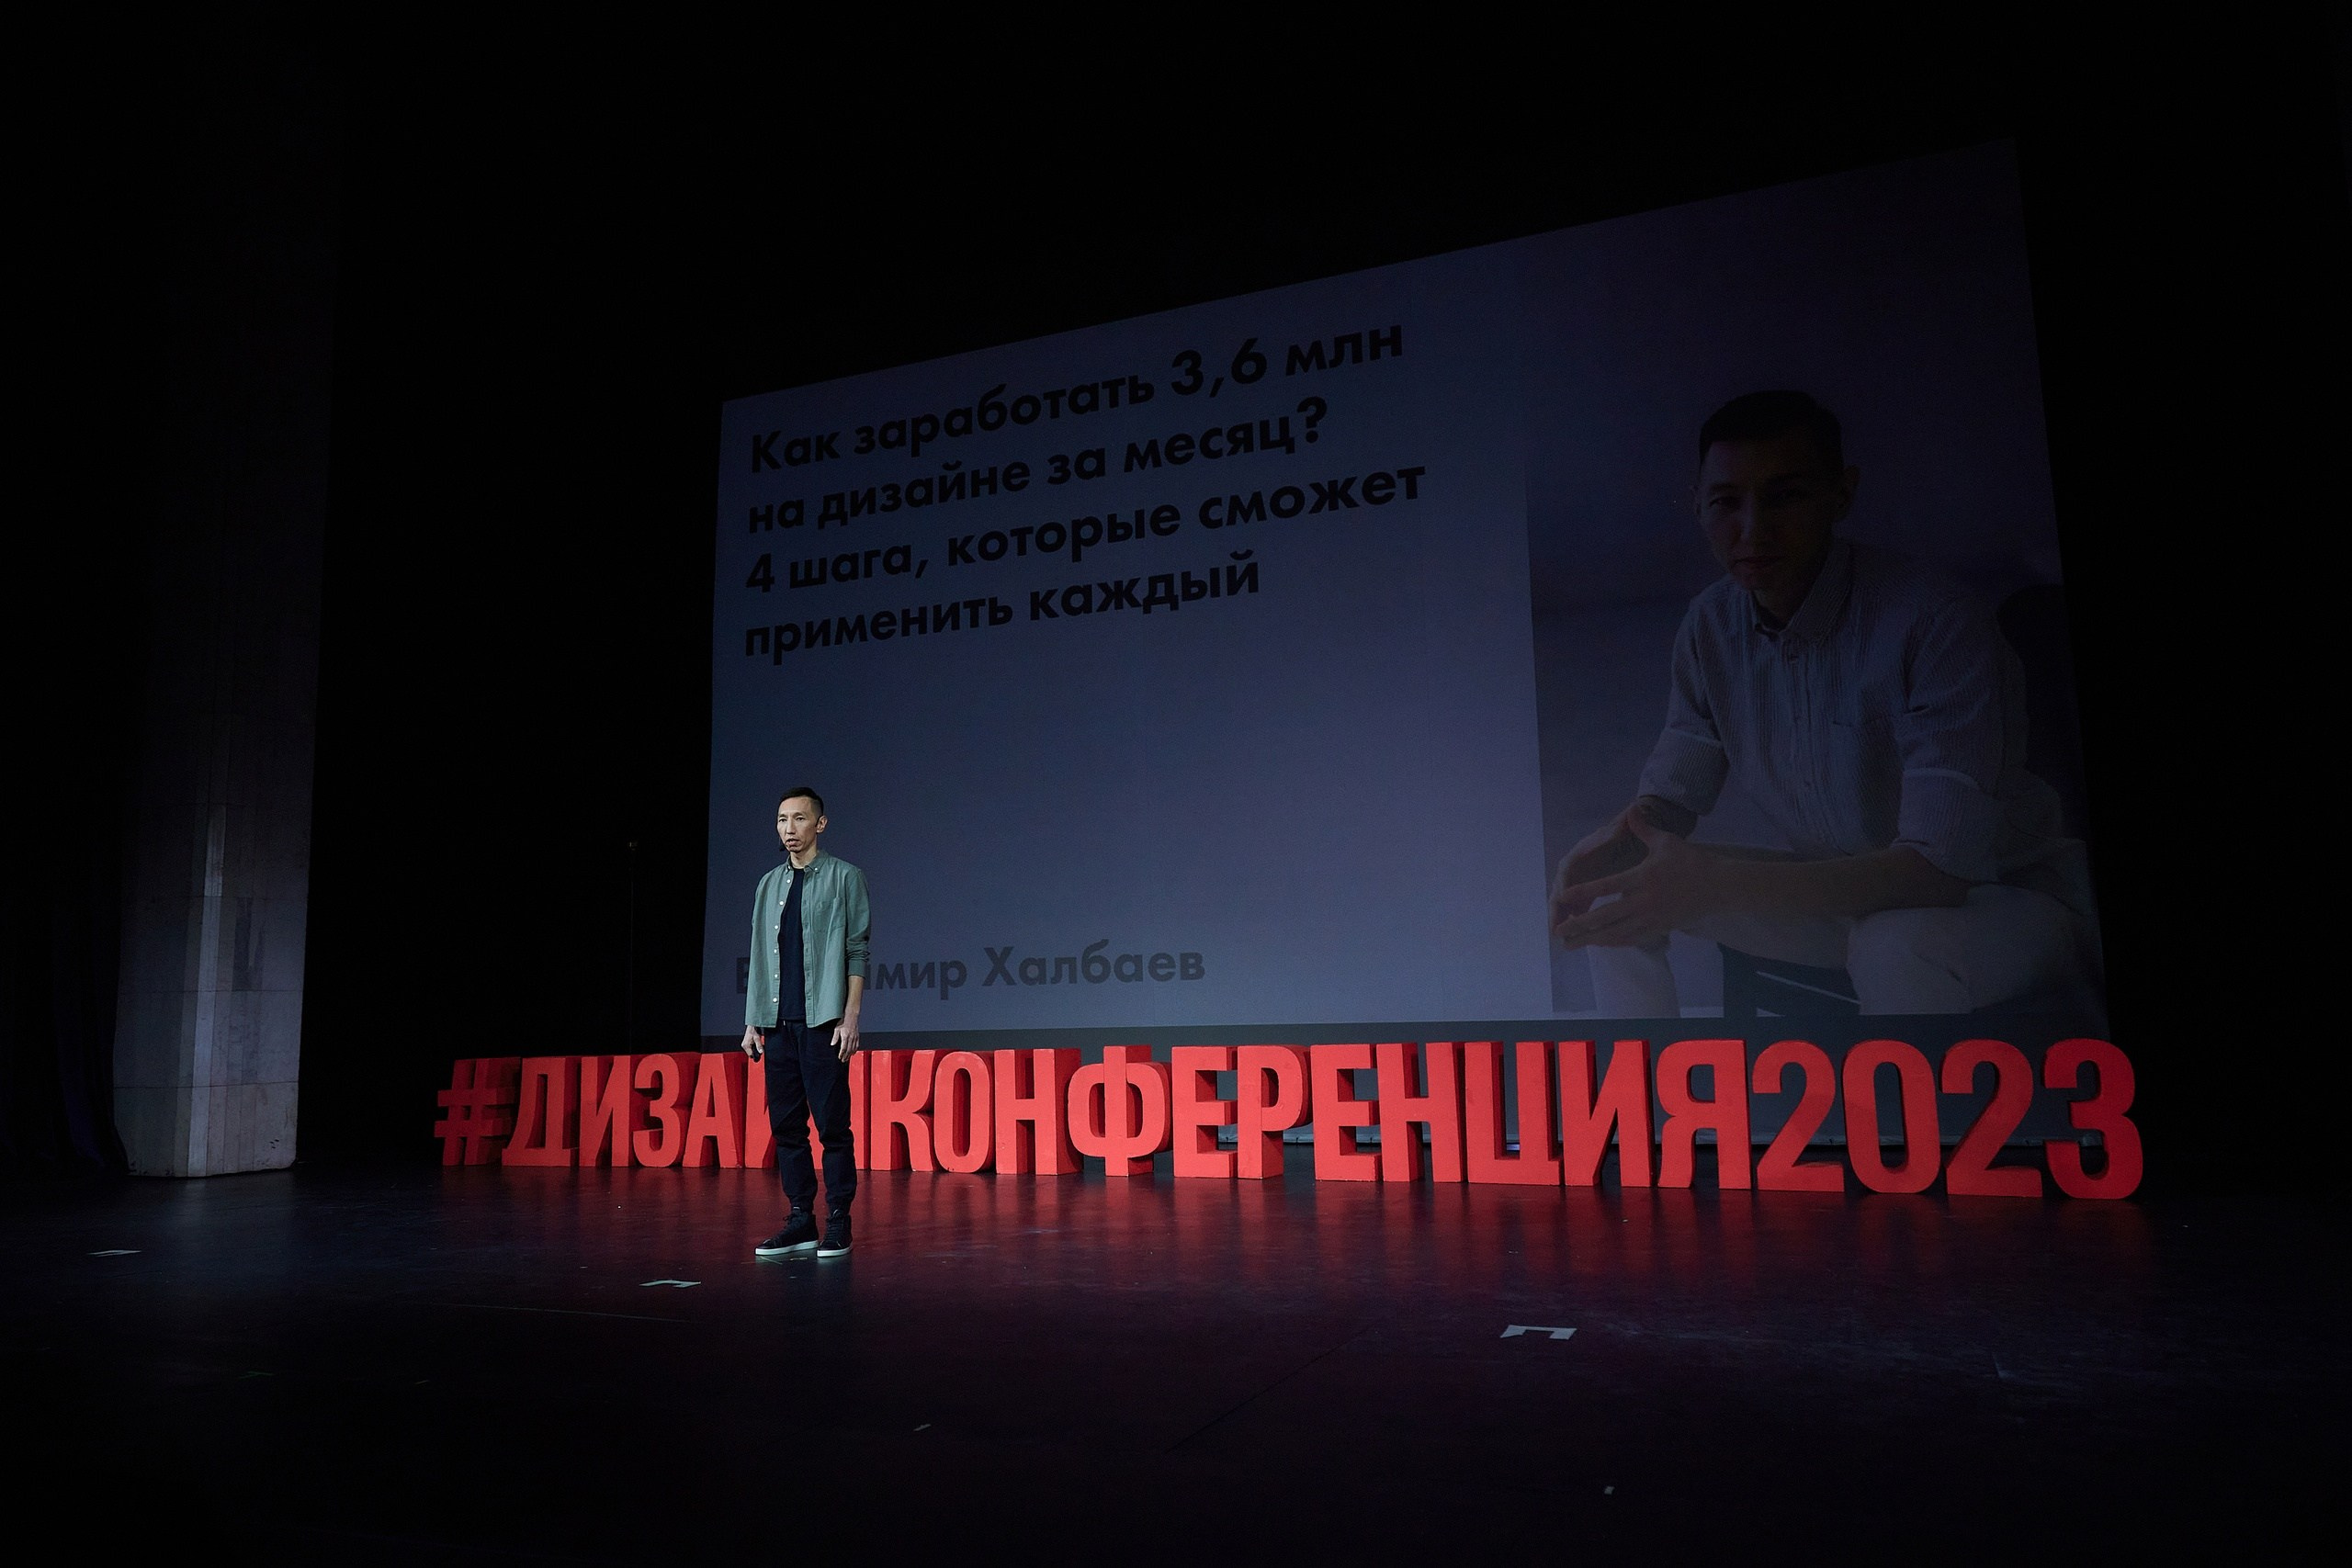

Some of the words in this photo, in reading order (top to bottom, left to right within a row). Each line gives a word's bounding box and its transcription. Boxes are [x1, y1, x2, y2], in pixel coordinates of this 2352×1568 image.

[752, 429, 841, 473] Как
[854, 374, 1155, 458] заработать
[1170, 337, 1268, 398] 3,6
[1285, 324, 1404, 376] млн
[749, 498, 805, 534] на
[818, 460, 1031, 529] дизайне
[1047, 446, 1106, 485] за
[1123, 396, 1327, 473] месяц?
[745, 553, 775, 592] 4
[789, 544, 929, 590] шага,
[948, 503, 1181, 563] которые
[1198, 466, 1426, 530] сможет
[745, 596, 1013, 666] применить
[1029, 548, 1259, 621] каждый
[981, 939, 1206, 988] Халбаев
